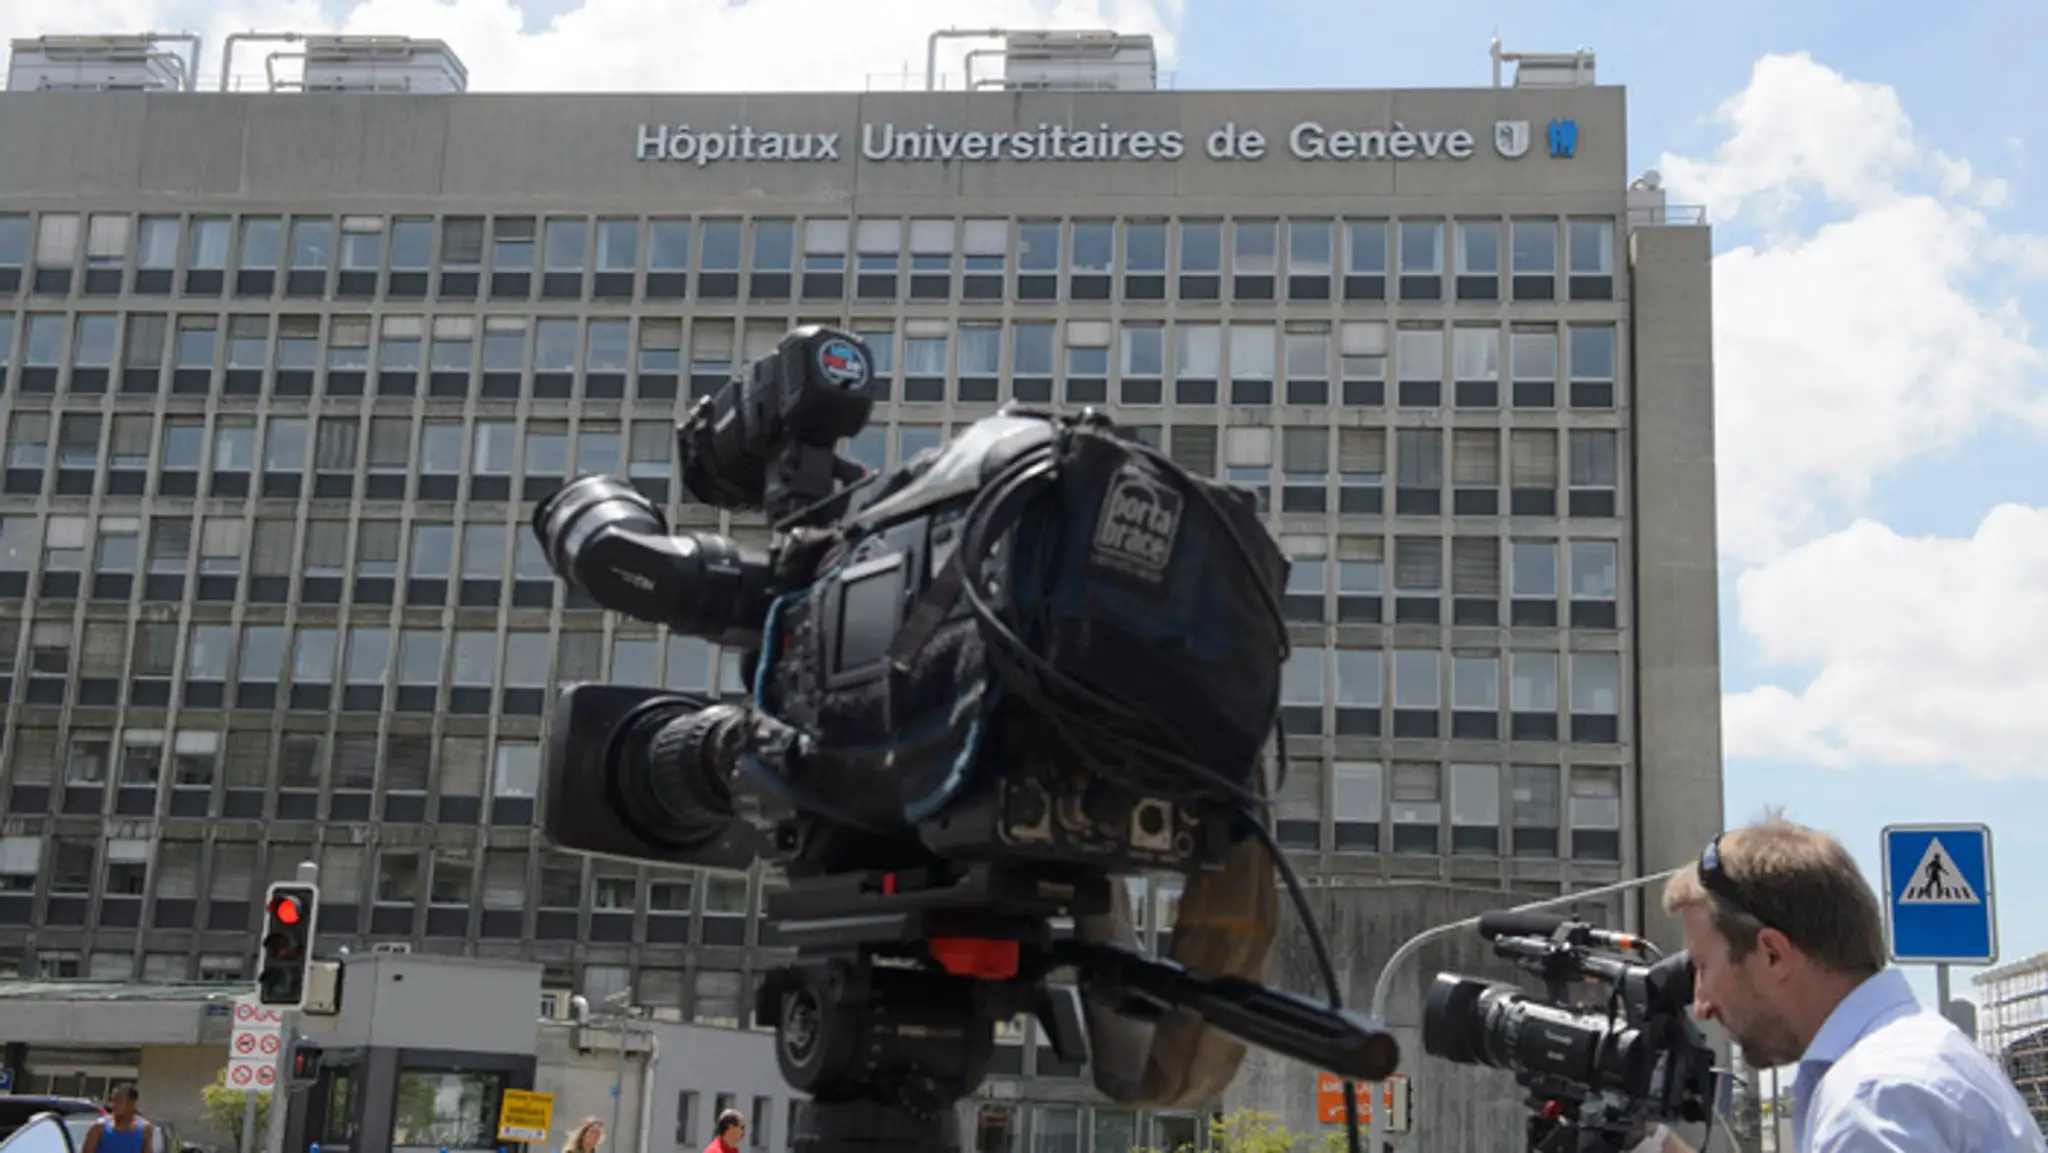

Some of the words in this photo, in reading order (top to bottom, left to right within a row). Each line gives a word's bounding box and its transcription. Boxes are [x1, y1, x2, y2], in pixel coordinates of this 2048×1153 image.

[635, 124, 841, 167] Hôpitaux
[861, 123, 1185, 160] Universitaires
[1206, 122, 1267, 158] de
[1288, 121, 1475, 159] Genève
